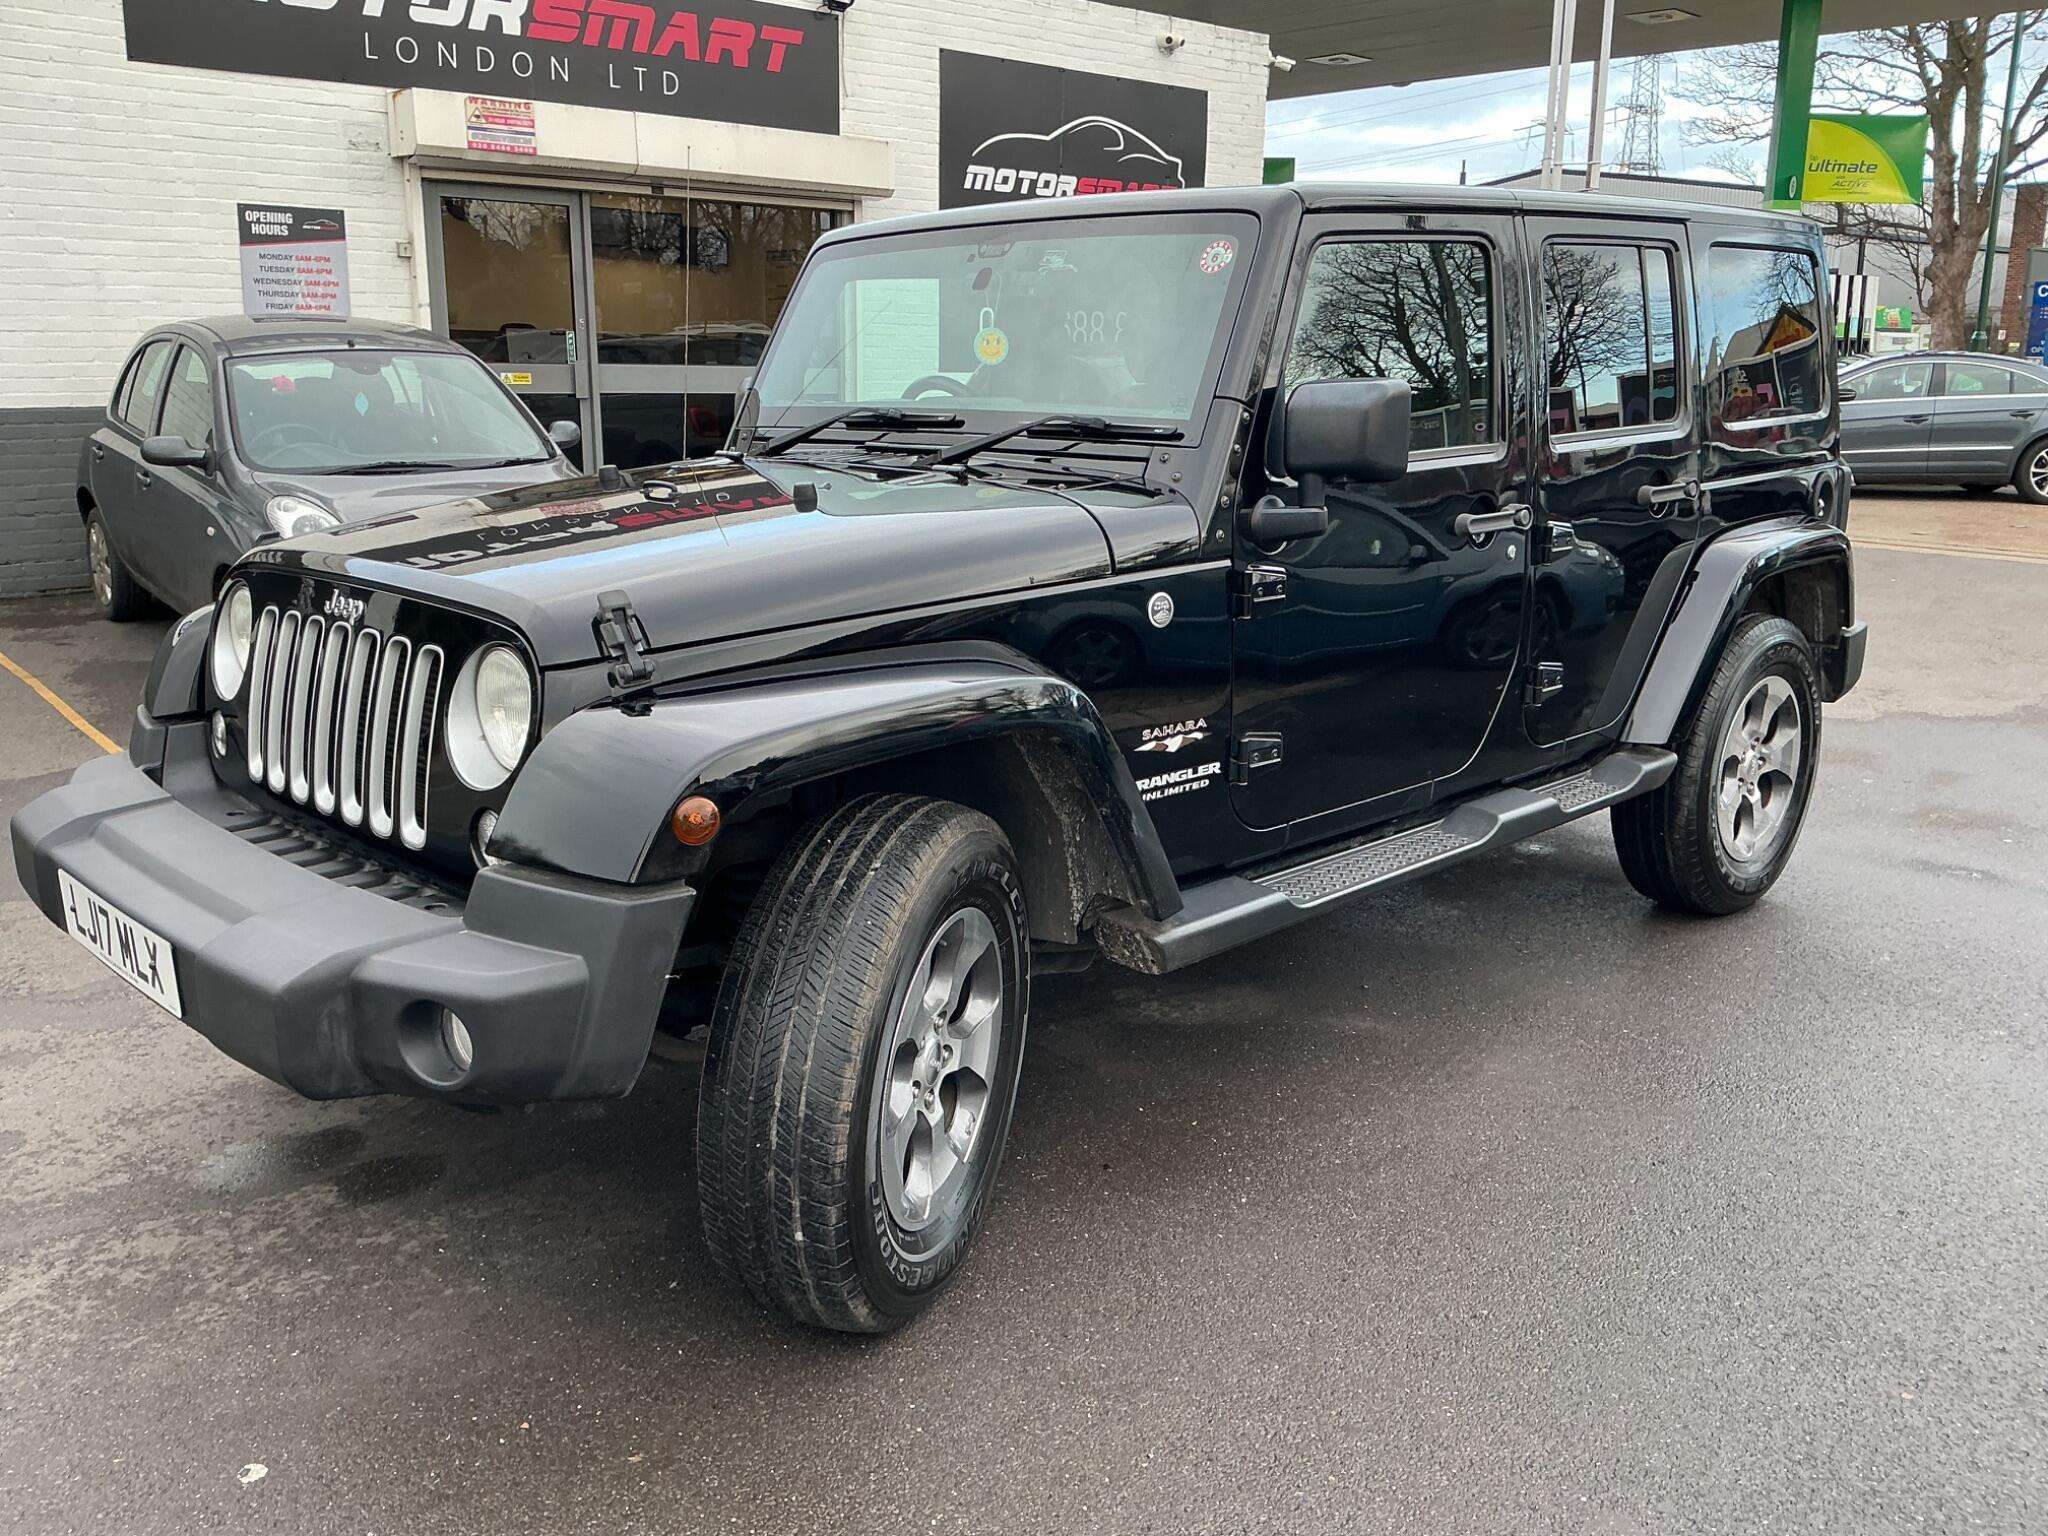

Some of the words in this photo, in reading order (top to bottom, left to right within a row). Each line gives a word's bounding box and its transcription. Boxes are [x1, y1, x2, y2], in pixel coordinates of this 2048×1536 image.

[257, 0, 804, 73] ORSMART
[364, 32, 569, 82] LONDON
[609, 63, 680, 95] LTD
[469, 96, 532, 110] WARNING
[1808, 159, 1878, 173] ultimate
[1832, 180, 1870, 188] ACTIVE
[245, 210, 293, 224] OPENING
[251, 223, 289, 236] HOURS
[258, 253, 294, 261] MONDAY
[259, 265, 295, 273] TUESDAY
[253, 277, 303, 286] WEDNESDAY
[257, 289, 300, 298] THURSDAY
[324, 589, 364, 626] Jeep
[1142, 718, 1207, 741] SAHARA
[1135, 762, 1221, 791] RANGLER
[69, 883, 112, 957] LJ17
[115, 916, 165, 995] NLX
